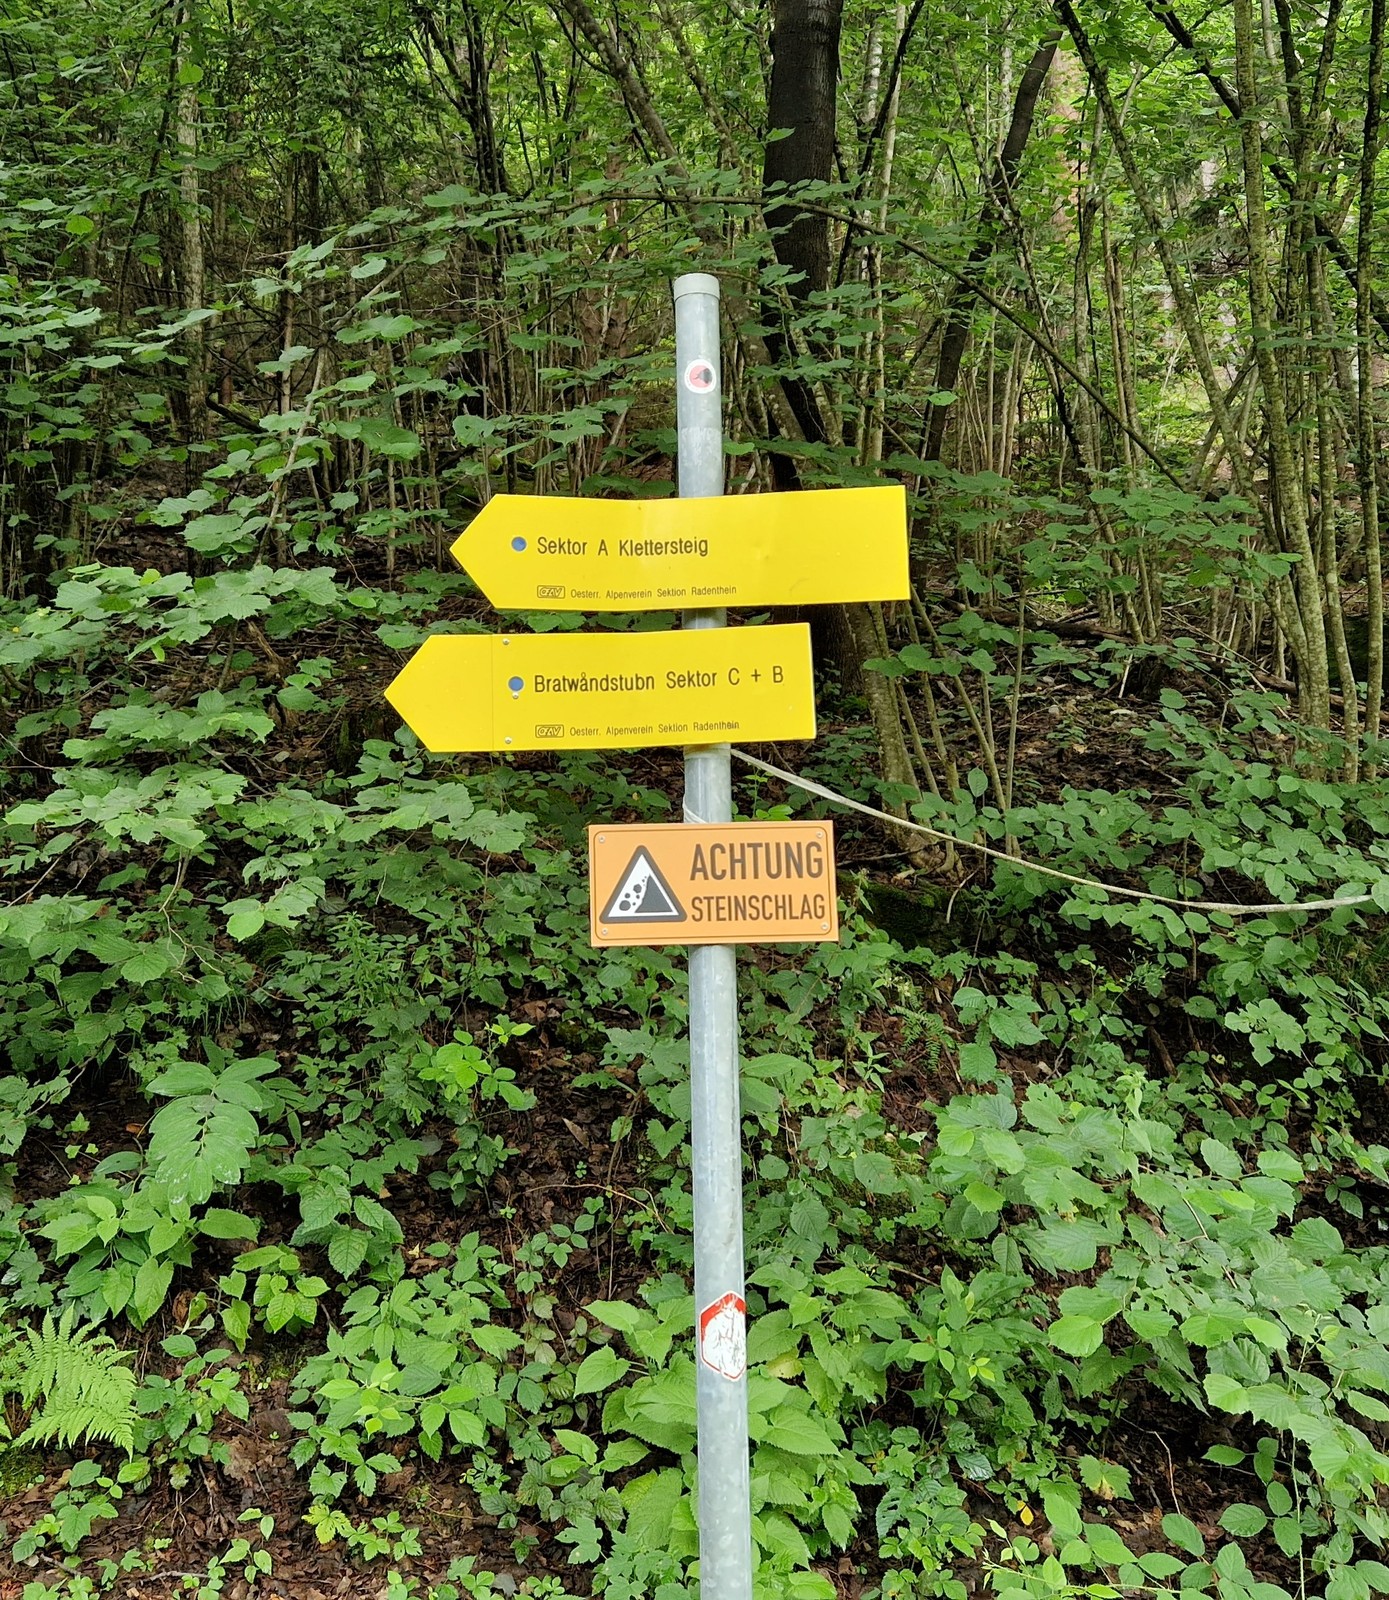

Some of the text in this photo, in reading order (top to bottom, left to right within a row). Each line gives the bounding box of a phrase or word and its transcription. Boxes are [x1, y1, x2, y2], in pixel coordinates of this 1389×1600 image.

[537, 536, 708, 558] Sektor A Klettersteig
[570, 588, 601, 599] Oesterr.
[605, 588, 653, 600] Alpenverein
[656, 587, 687, 598] Sektion
[691, 585, 737, 596] Radenthein
[534, 665, 784, 693] Bratwåndstubn Sektor C + B
[569, 726, 601, 737] Oesterr.
[605, 724, 653, 738] Alpenverein
[658, 722, 688, 734] Sektion
[693, 720, 740, 732] Radenthein
[690, 841, 823, 881] ACHTUNG
[691, 893, 825, 922] STEINSCHLAG
